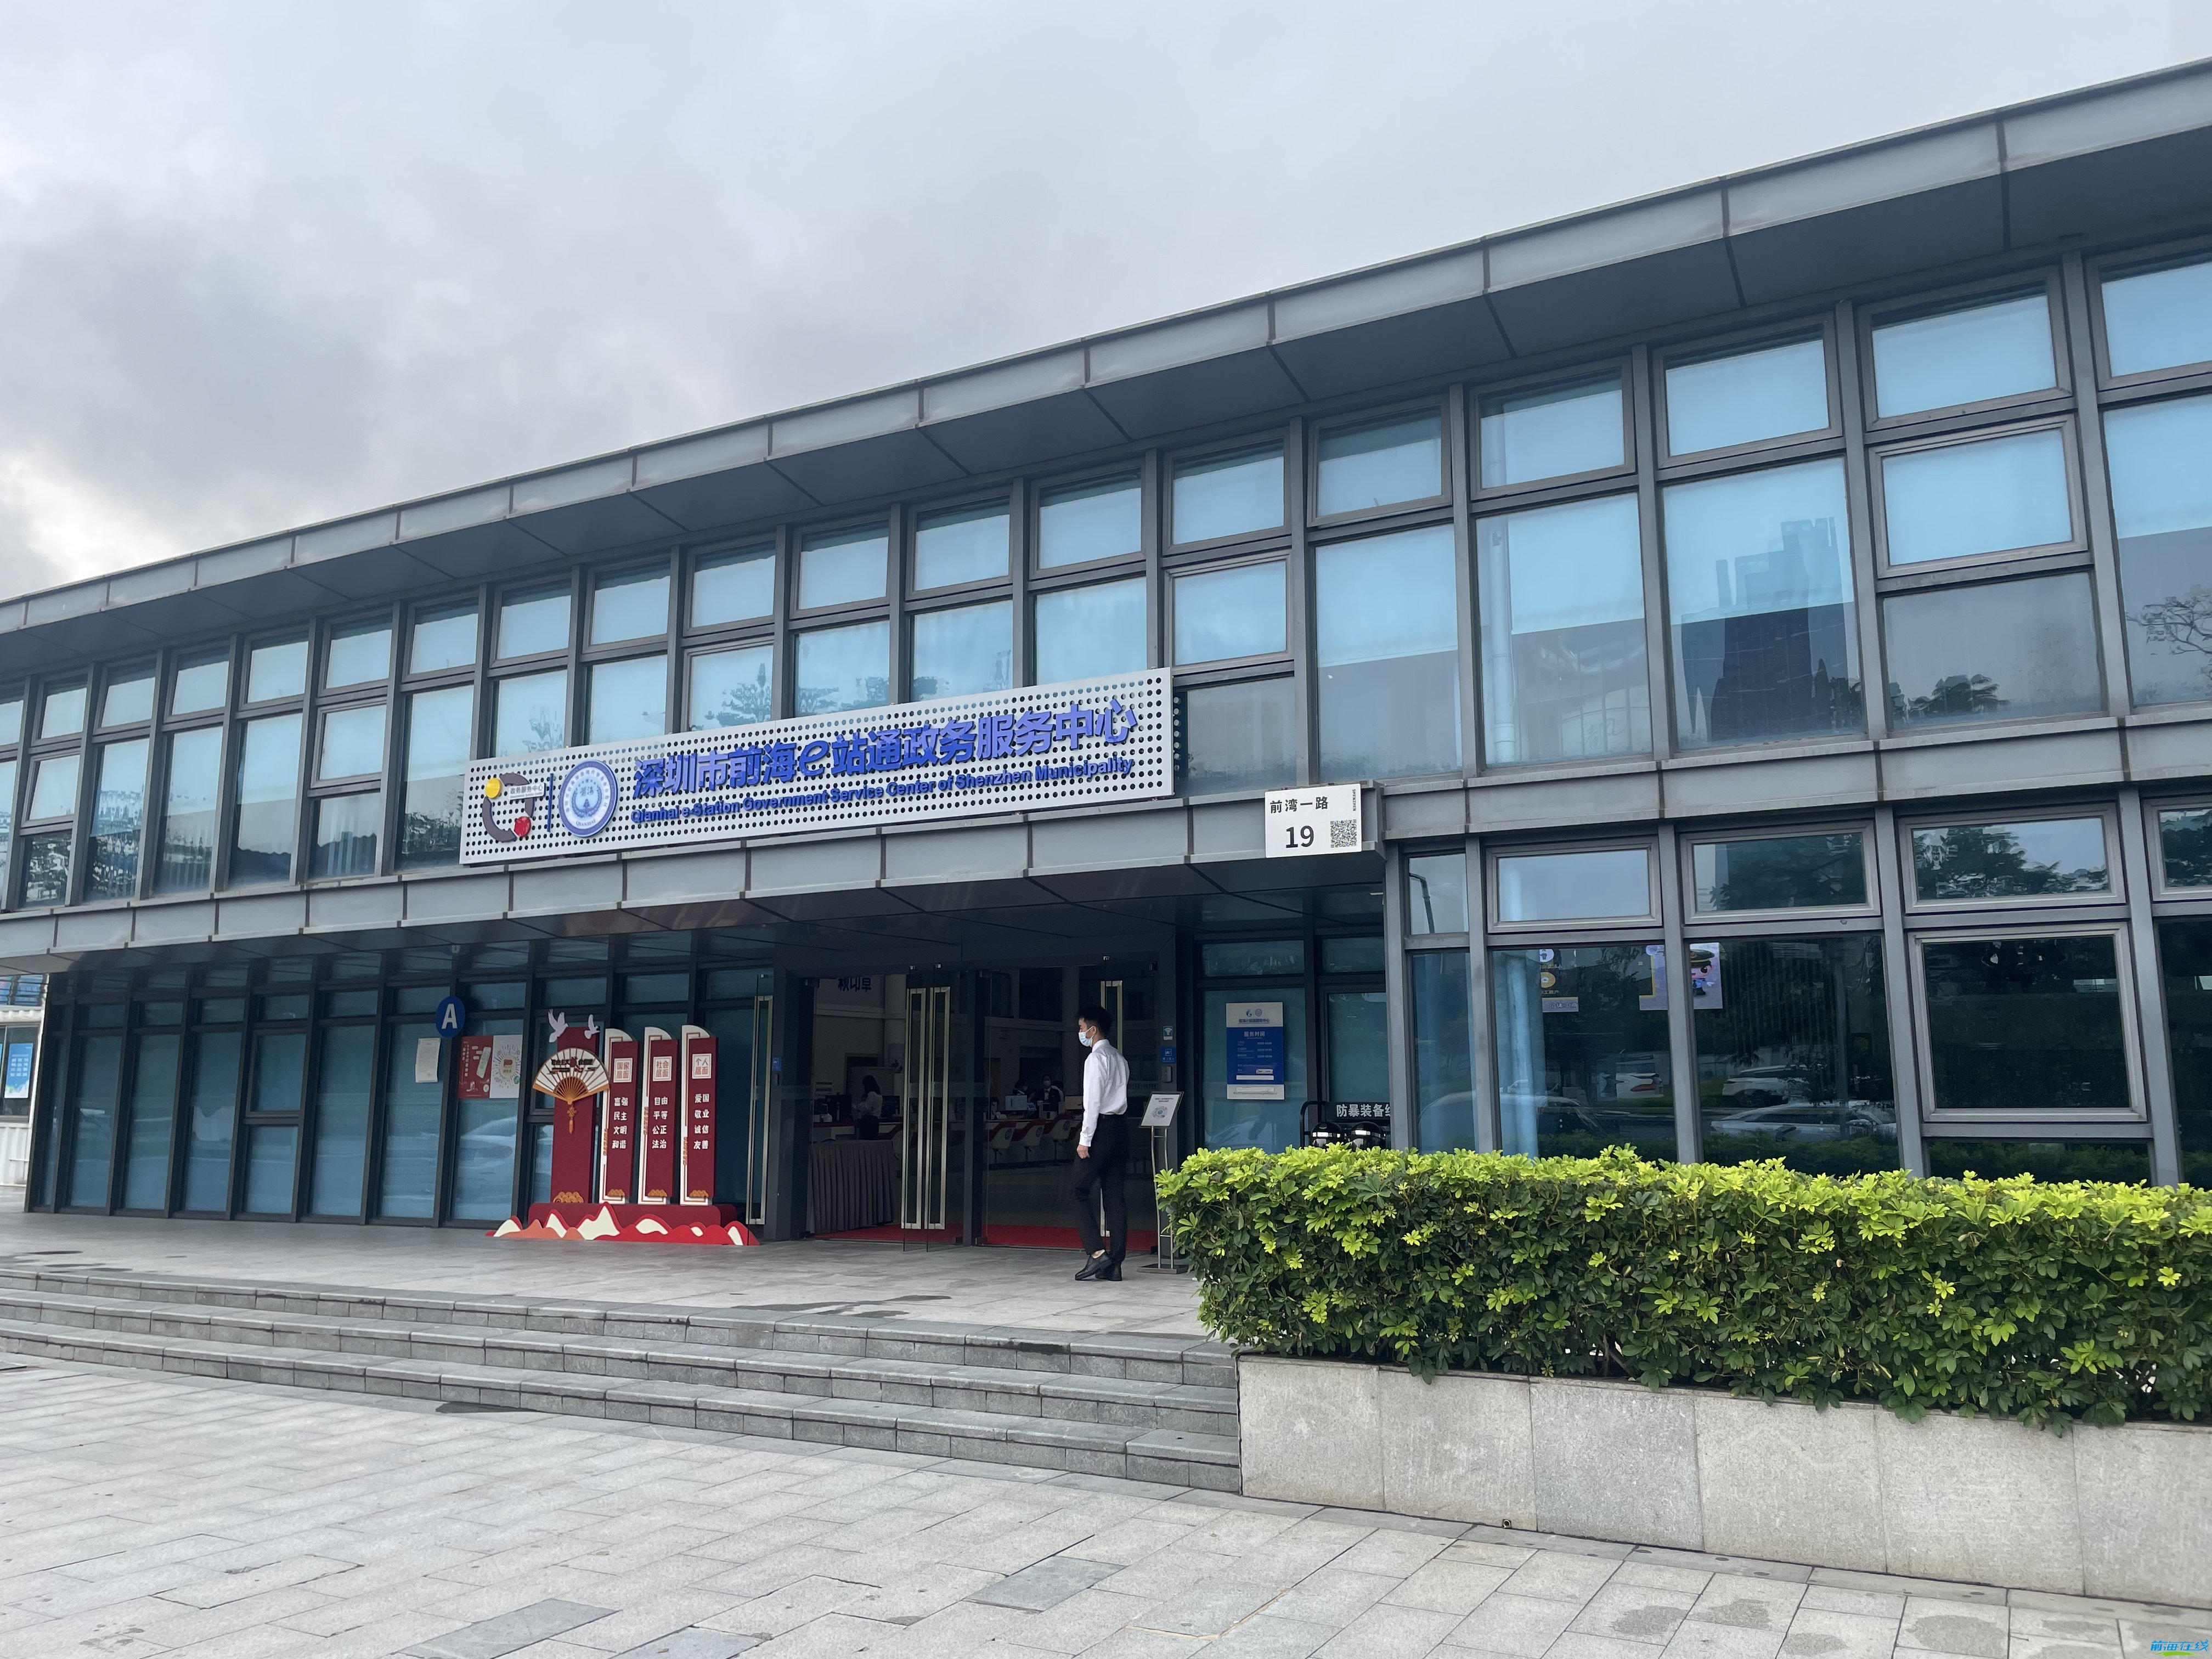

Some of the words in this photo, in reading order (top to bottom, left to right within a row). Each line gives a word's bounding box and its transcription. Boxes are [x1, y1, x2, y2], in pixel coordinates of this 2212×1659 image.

[633, 698, 1138, 799] 深圳市前海e站通政务服务中心
[510, 784, 543, 794] 政务服务中心
[631, 805, 679, 823] Qianhai
[682, 799, 741, 818] e-Station
[743, 790, 828, 811] Government
[830, 784, 884, 803] Service
[886, 777, 934, 797] Center
[938, 774, 954, 791] of
[956, 768, 1032, 789] Shenzhen
[1035, 755, 1134, 782] Municipality
[1270, 796, 1328, 814] 前湾一路
[1285, 825, 1314, 848] 19
[442, 1003, 458, 1029] A
[656, 1060, 669, 1069] 社会
[696, 1058, 708, 1066] 个人
[654, 1096, 668, 1105] 自由
[695, 1093, 709, 1103] 爱国
[613, 1111, 627, 1120] 民主
[653, 1110, 668, 1120] 平等
[694, 1109, 709, 1119] 敬业
[613, 1126, 627, 1135] 文明
[652, 1125, 667, 1135] 公正
[694, 1125, 709, 1134] 诚信
[612, 1140, 627, 1149] 和谐
[652, 1139, 667, 1149] 法治
[693, 1140, 708, 1149] 友善
